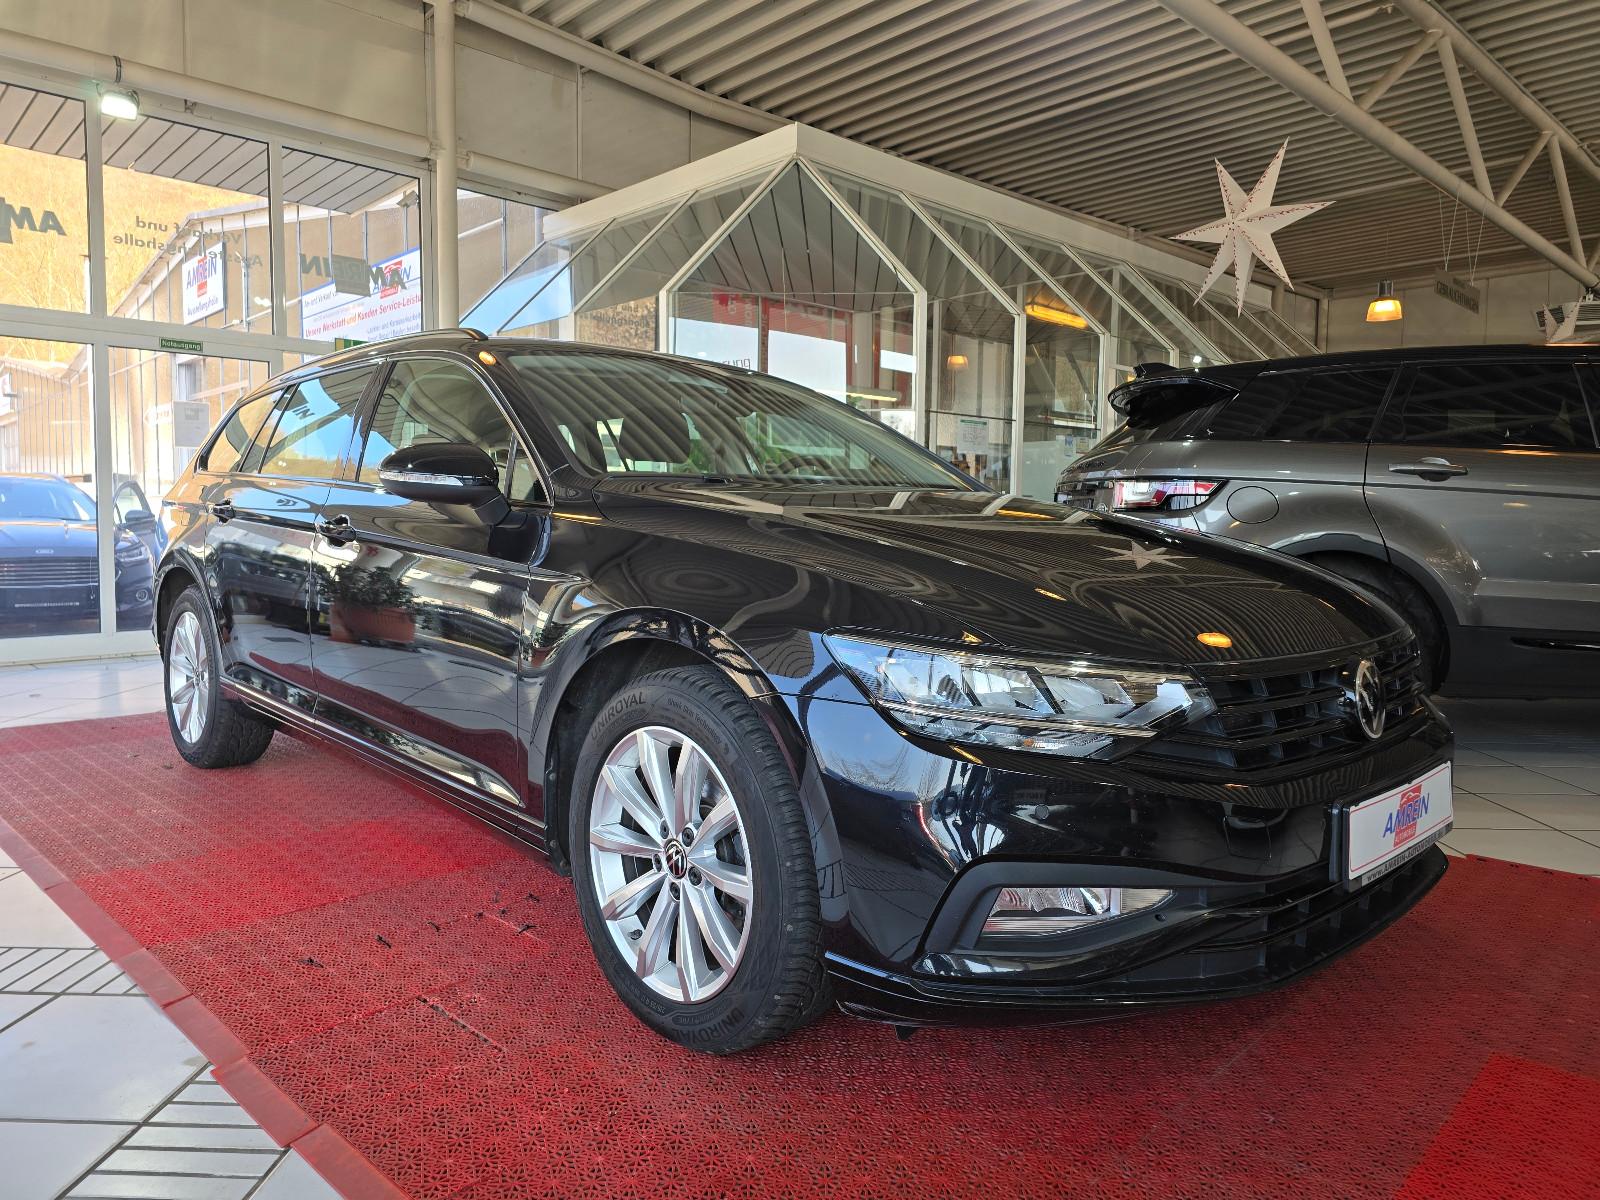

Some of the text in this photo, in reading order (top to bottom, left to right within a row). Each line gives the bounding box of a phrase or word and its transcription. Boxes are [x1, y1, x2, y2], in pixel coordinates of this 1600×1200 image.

[186, 257, 217, 289] AMREIN
[161, 339, 201, 351] Notausgang
[591, 692, 646, 741] UNIROYAL
[1382, 792, 1430, 838] AMREIN
[671, 1007, 745, 1044] UNIROYAL
